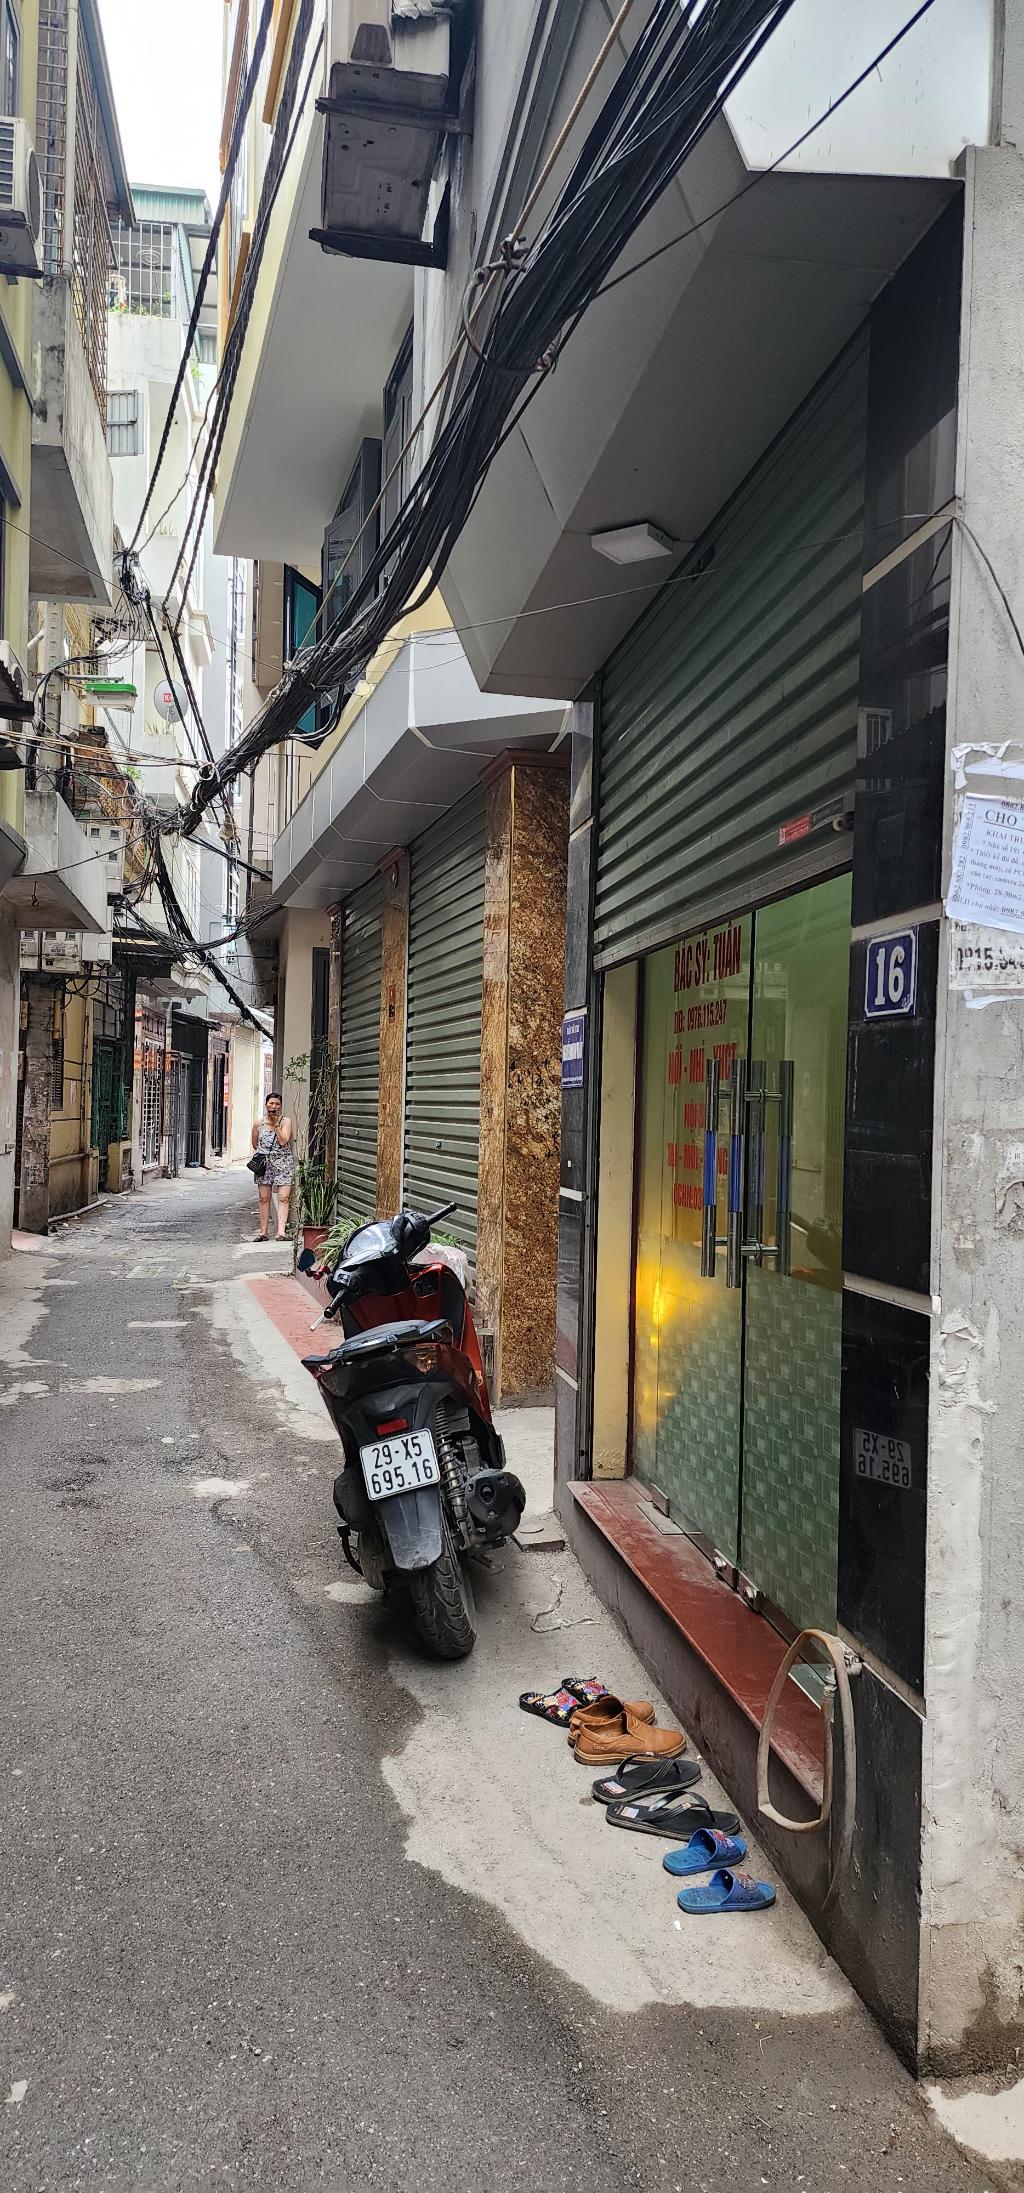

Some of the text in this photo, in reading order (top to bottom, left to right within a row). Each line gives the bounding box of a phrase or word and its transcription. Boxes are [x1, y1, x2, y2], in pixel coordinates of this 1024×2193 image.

[985, 810, 1018, 826] CHO
[674, 940, 692, 992] BÁC
[874, 946, 904, 1006] 16
[372, 1436, 422, 1469] 29-X5
[371, 1458, 433, 1494] 695.16
